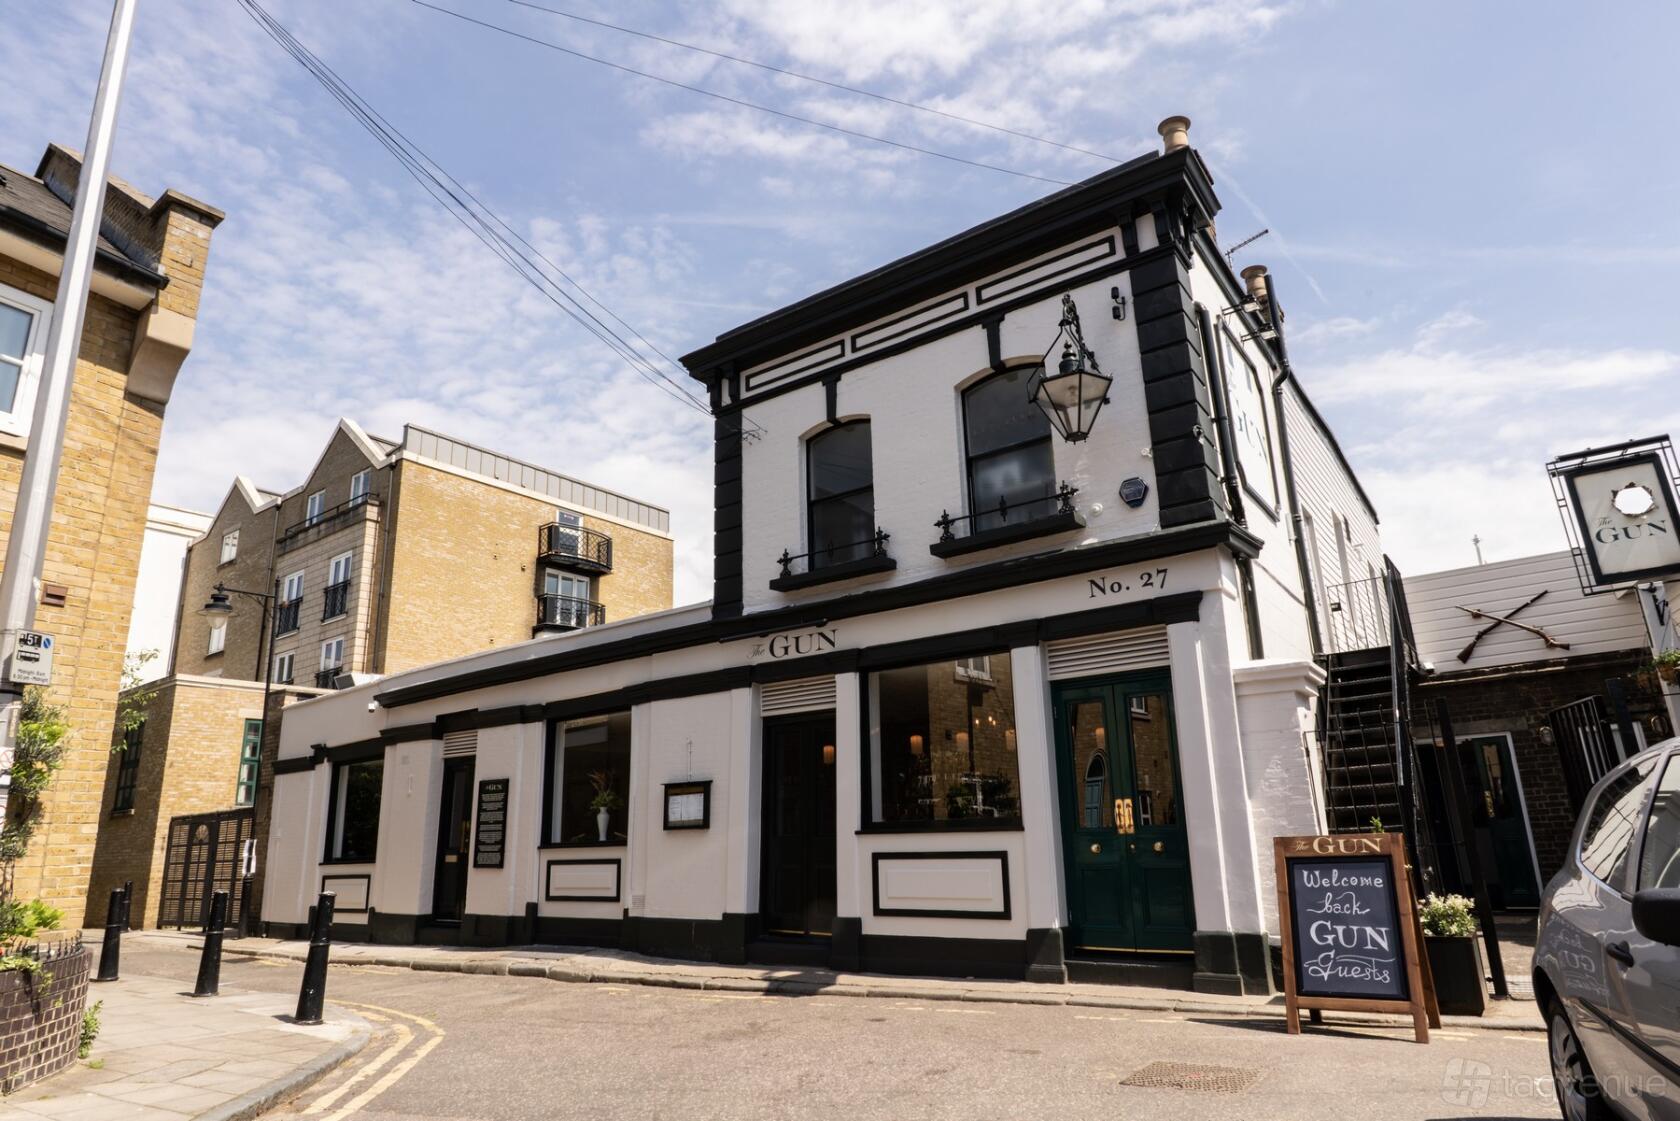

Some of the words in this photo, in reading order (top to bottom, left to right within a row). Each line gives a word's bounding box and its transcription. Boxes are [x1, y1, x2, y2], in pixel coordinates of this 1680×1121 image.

[1595, 520, 1668, 544] GUN
[1088, 576, 1130, 598] No.
[1140, 568, 1168, 589] 27
[768, 629, 839, 659] GUN
[1312, 836, 1384, 854] GUN
[1302, 869, 1384, 888] Welcome
[1306, 892, 1371, 915] back
[1310, 920, 1391, 951] GUN
[1303, 949, 1395, 983] Guests
